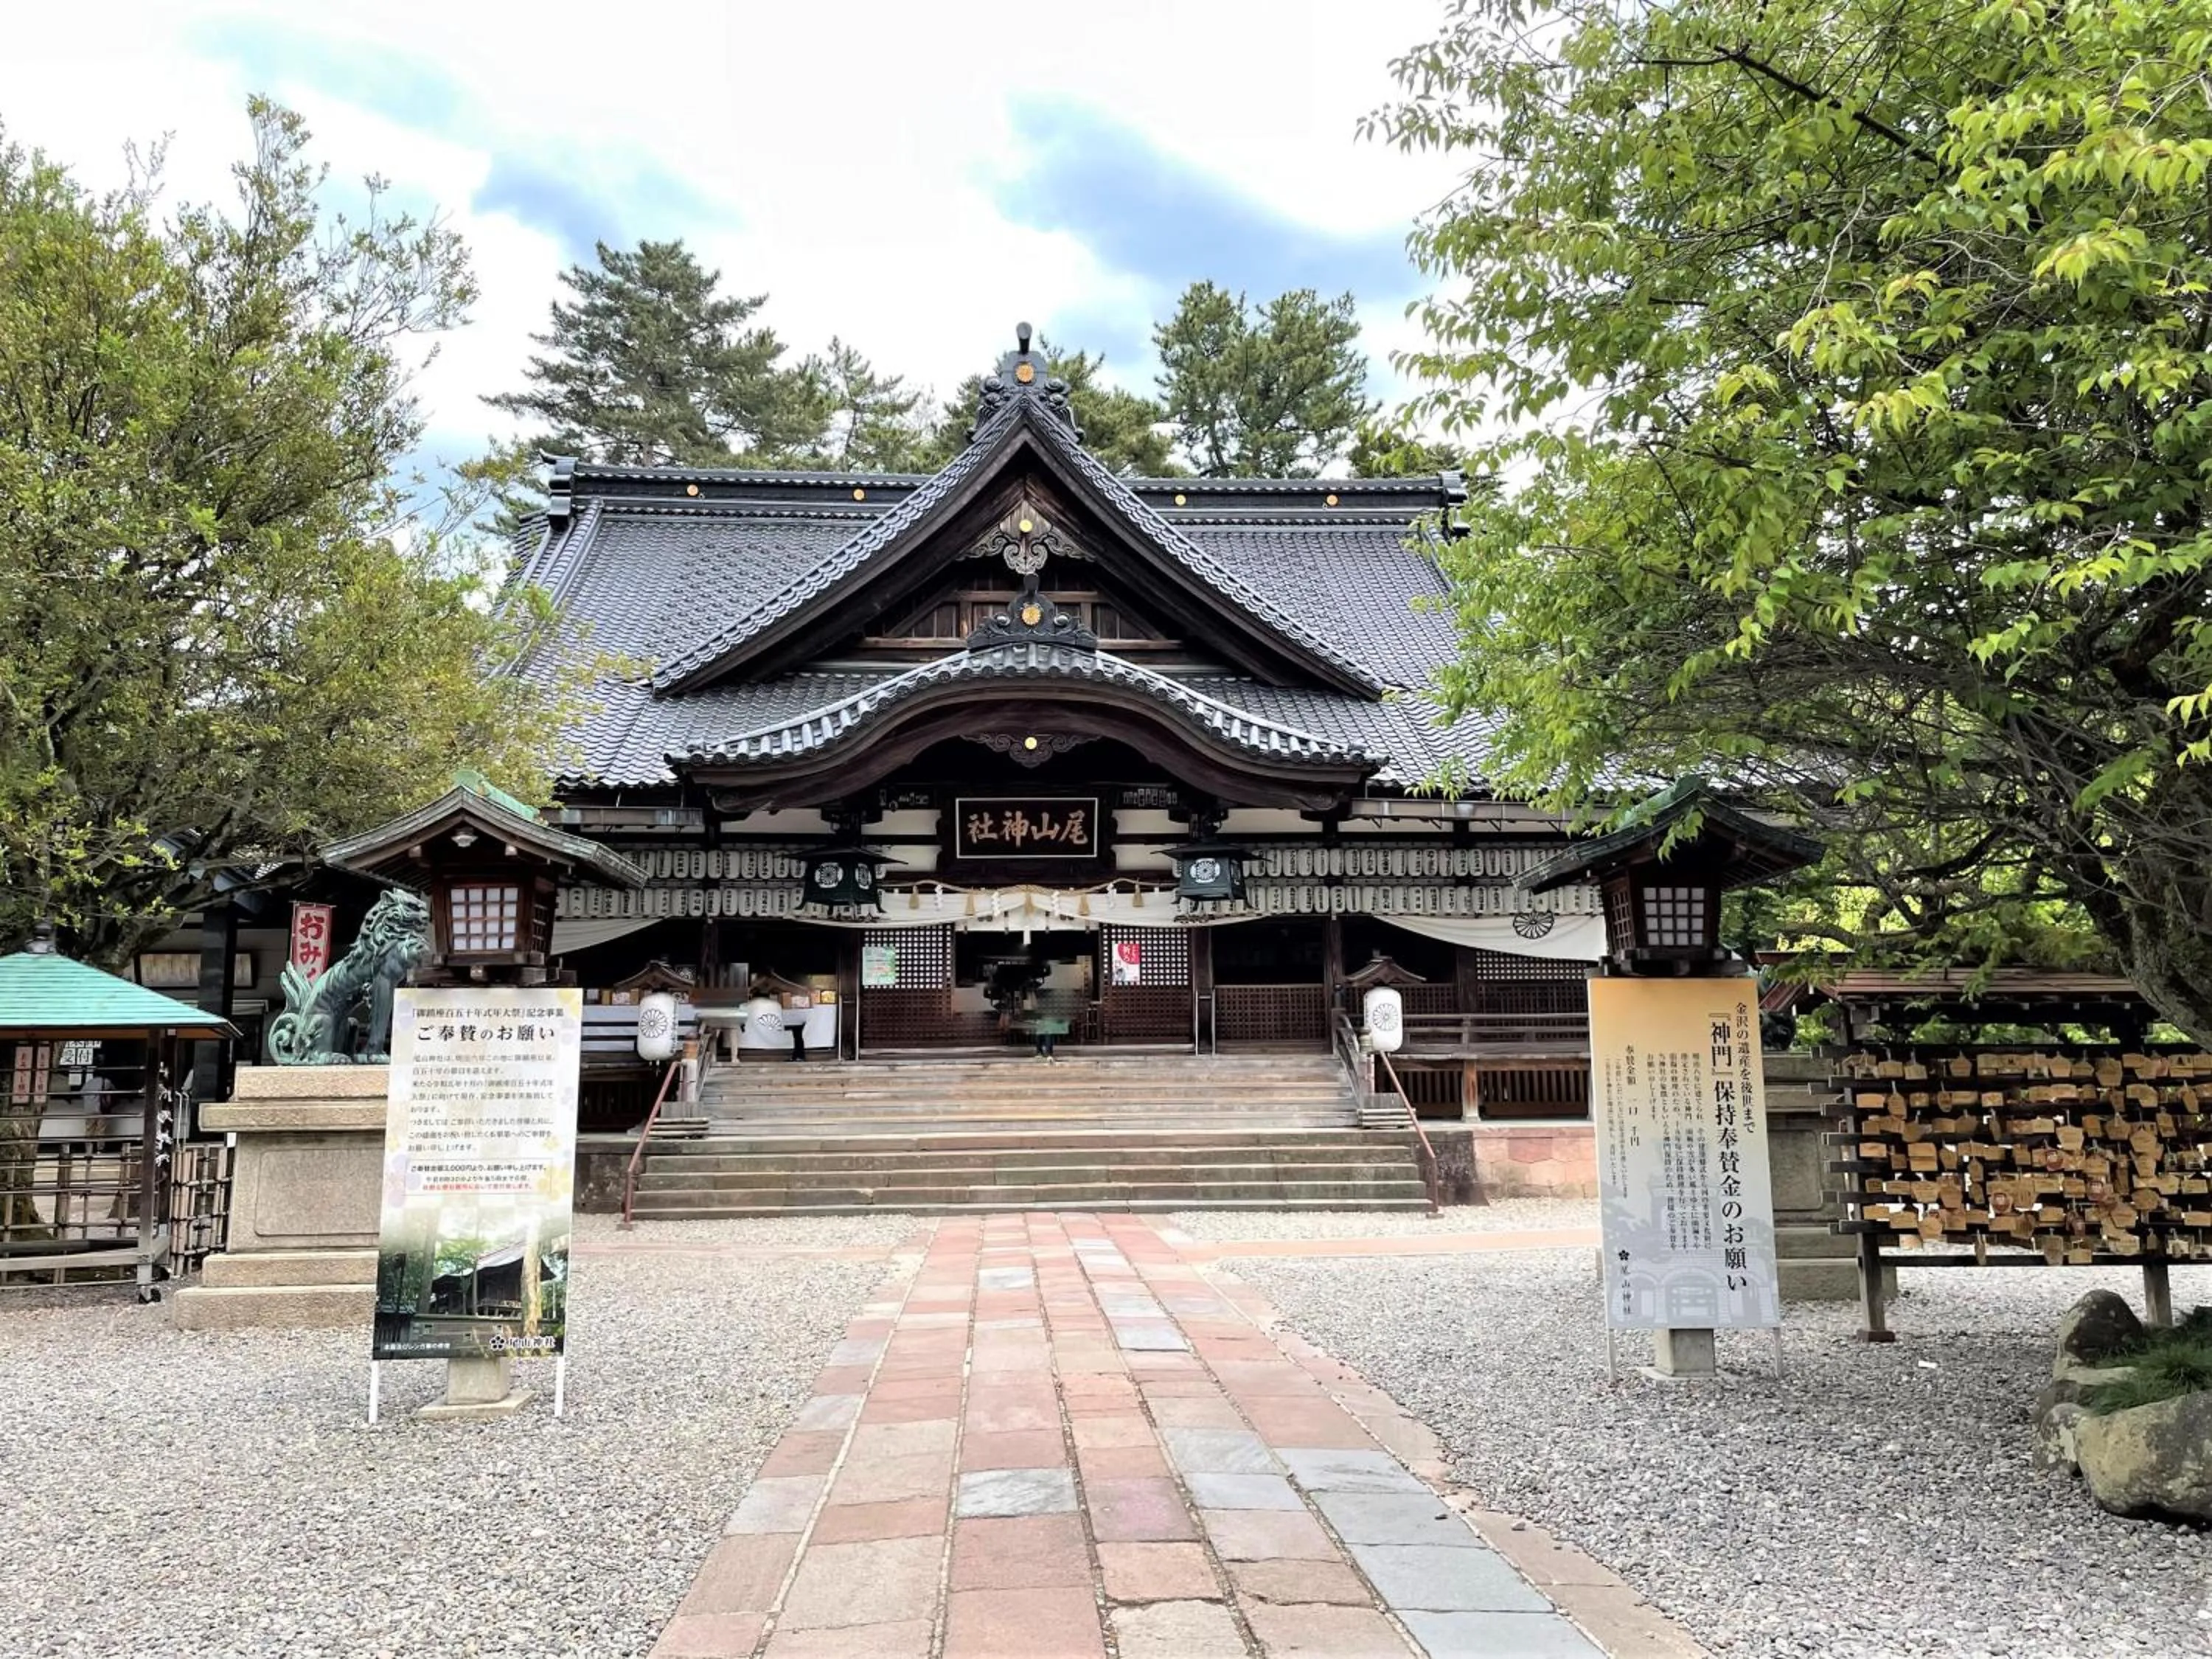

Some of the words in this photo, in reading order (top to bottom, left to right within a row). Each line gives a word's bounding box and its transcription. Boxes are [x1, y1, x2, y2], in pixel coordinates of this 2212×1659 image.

[417, 1025, 554, 1042] ご奉賛のお願い
[1736, 1002, 1755, 1134] 金沢の遺産を後世まで
[1708, 1012, 1747, 1291] 『神門』保持奉賛金のお願い
[1622, 1265, 1632, 1315] 尾山神社
